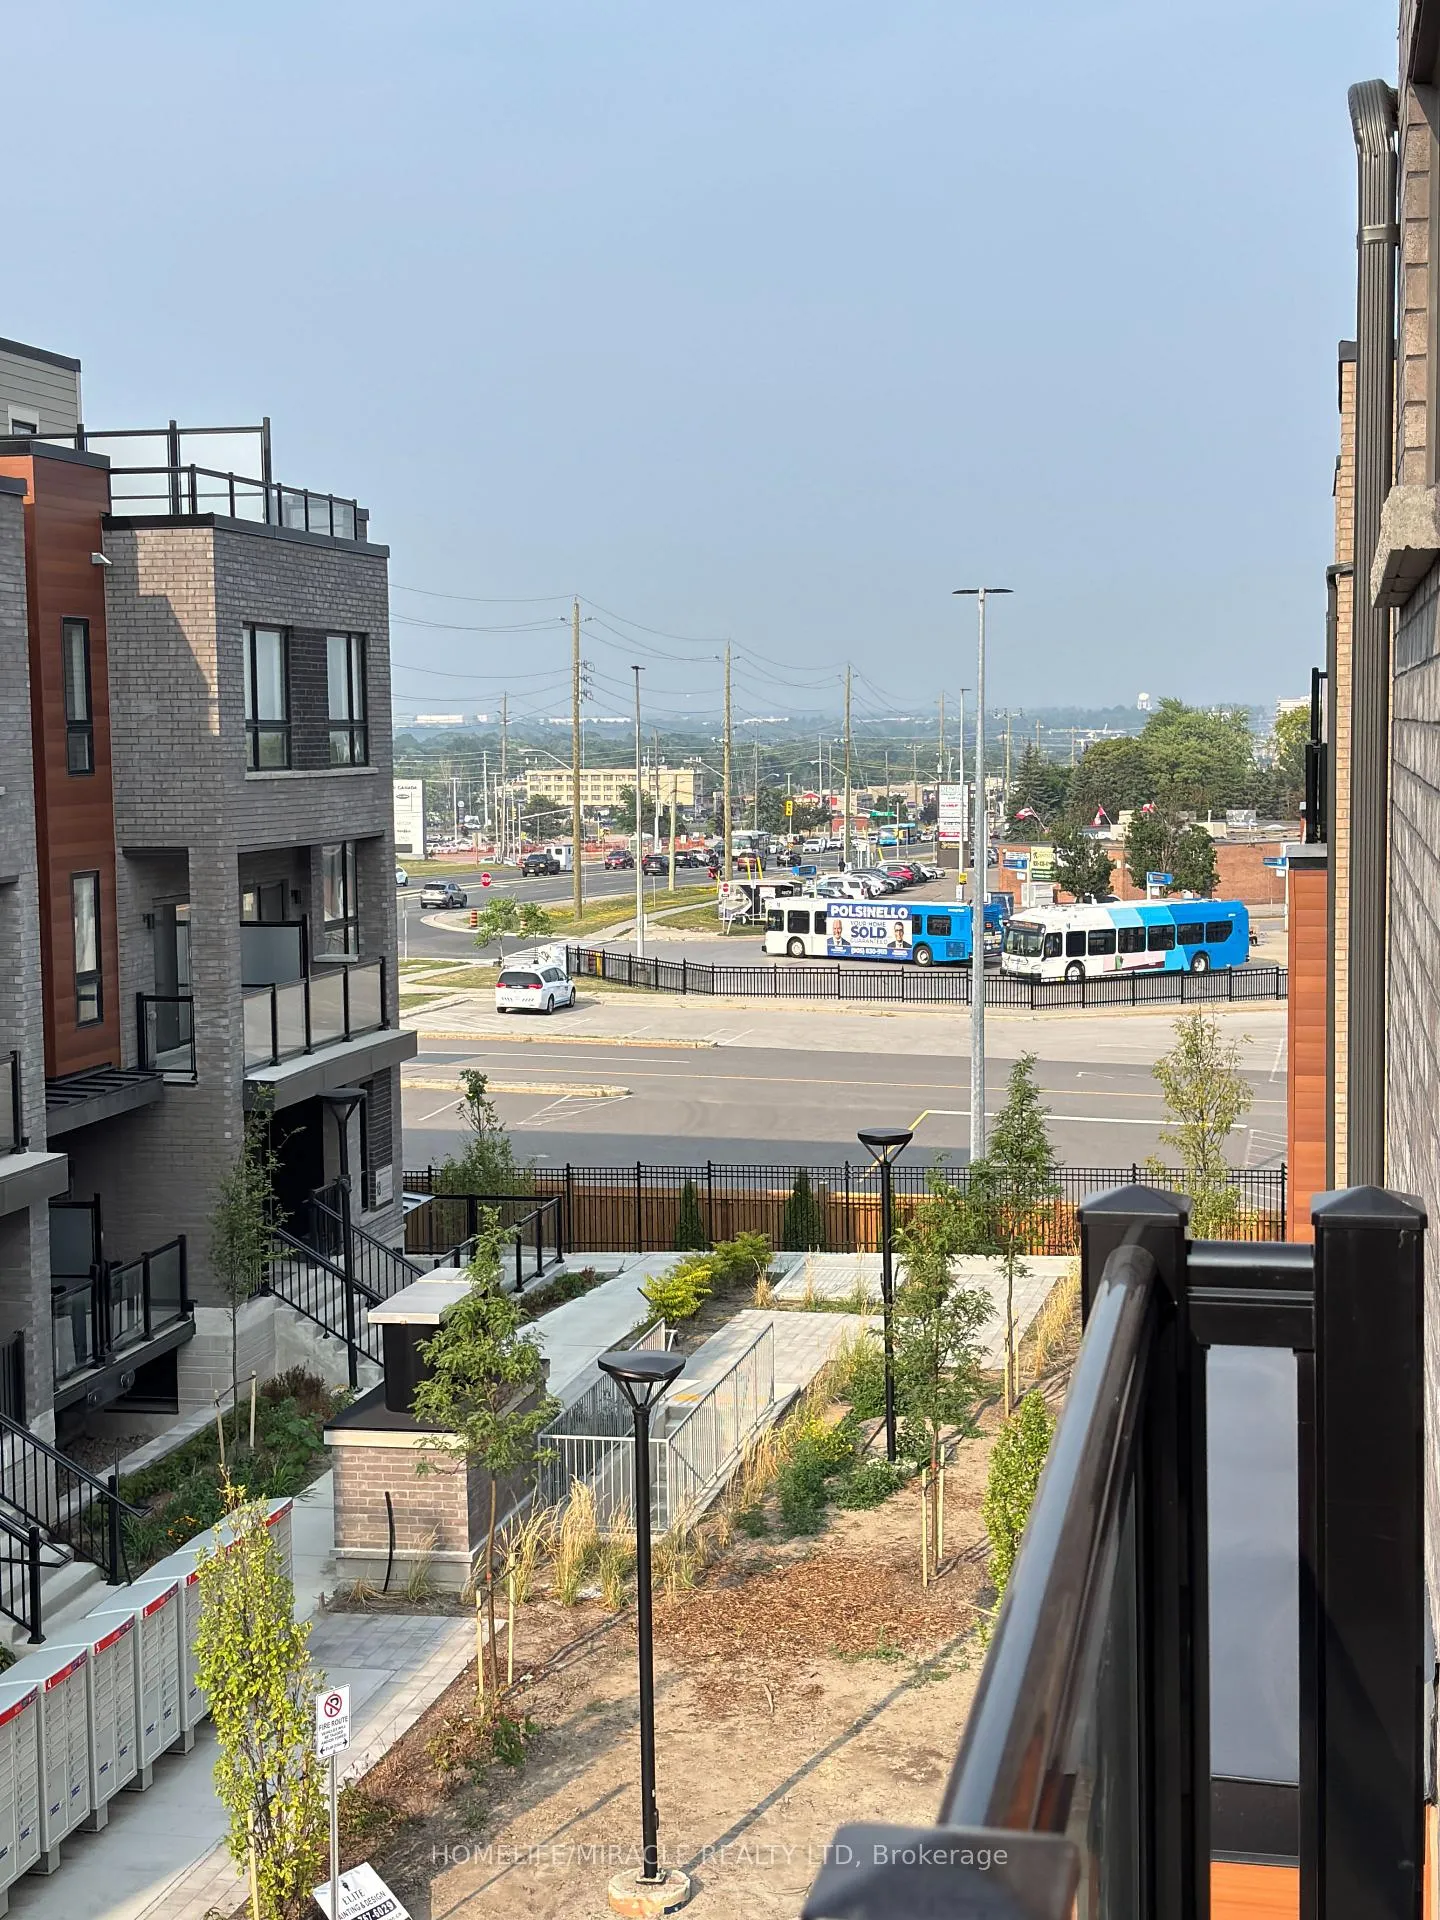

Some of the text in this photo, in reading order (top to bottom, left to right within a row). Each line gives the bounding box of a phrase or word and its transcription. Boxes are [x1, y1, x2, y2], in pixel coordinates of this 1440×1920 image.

[830, 904, 909, 919] POLSINELLO
[850, 925, 887, 939] SOLD
[318, 1715, 349, 1731] FIRE ROUTE
[342, 1888, 366, 1905] ELITE
[337, 1903, 361, 1920] AINTING
[364, 1890, 387, 1907] DESIGN
